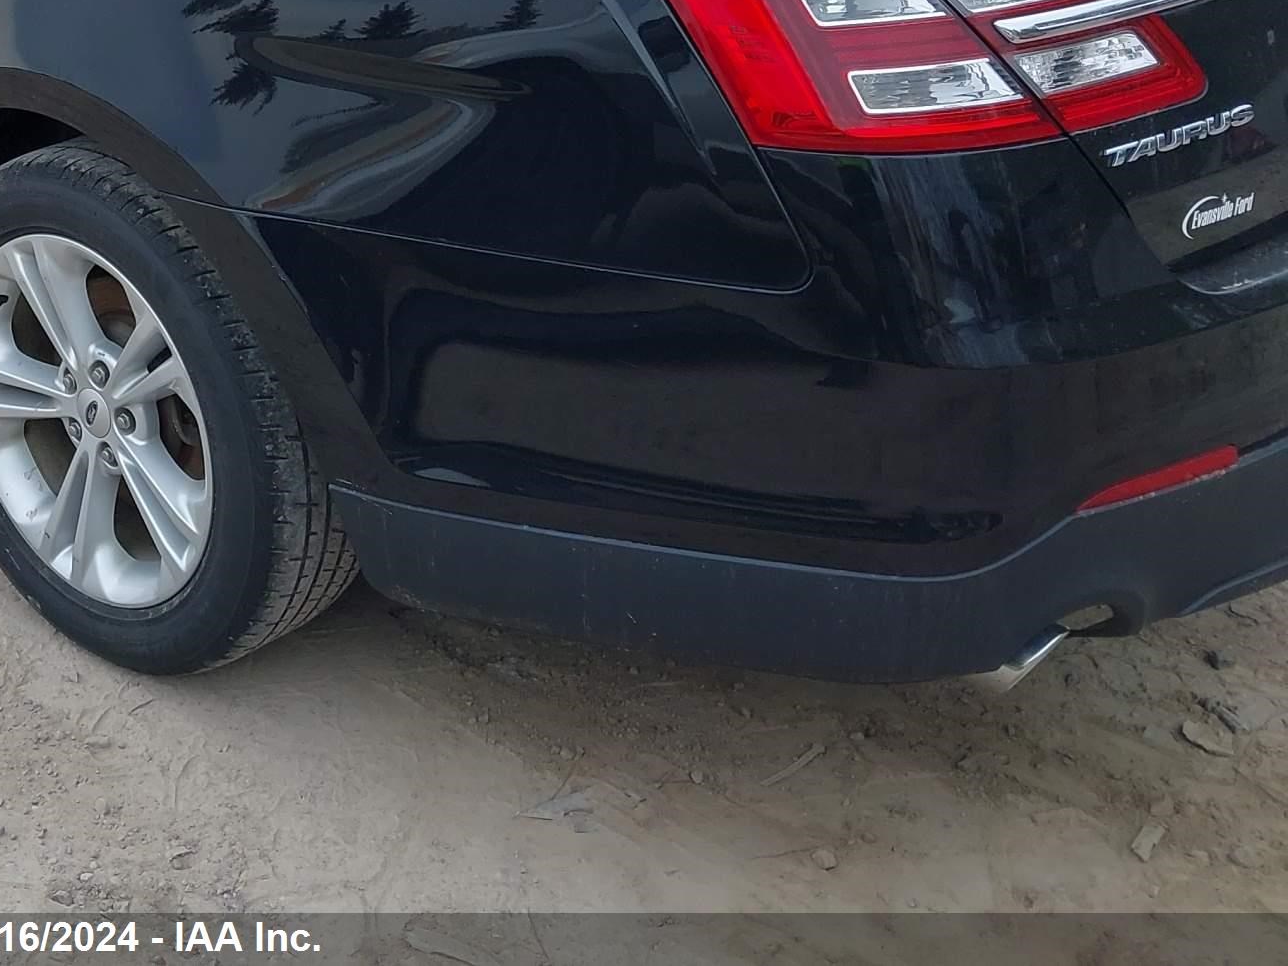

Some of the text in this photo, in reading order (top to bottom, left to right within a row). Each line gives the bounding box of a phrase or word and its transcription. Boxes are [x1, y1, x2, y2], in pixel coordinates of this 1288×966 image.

[1103, 104, 1256, 167] TAURUS
[1191, 192, 1255, 230] Evansville Ford
